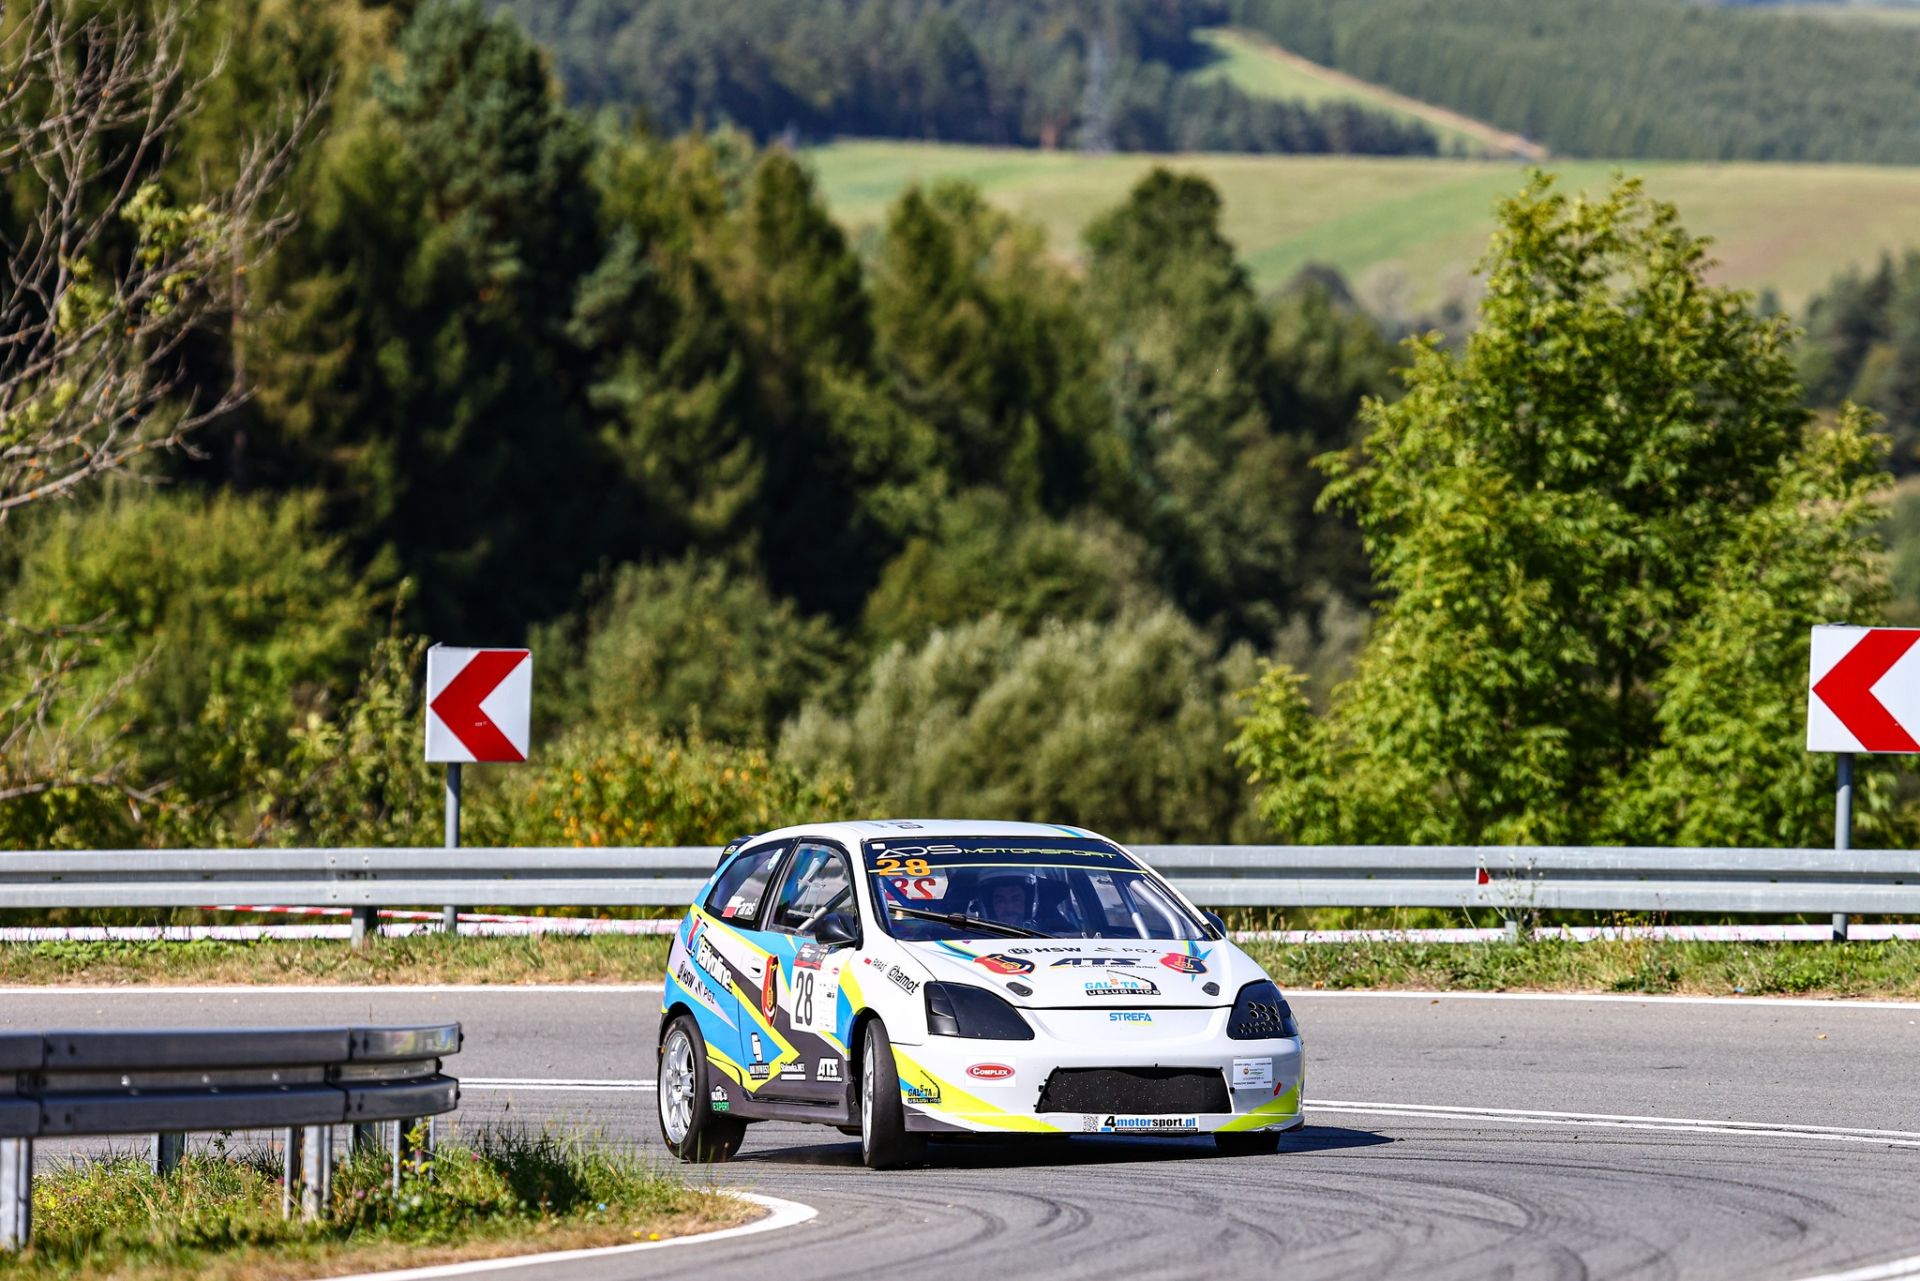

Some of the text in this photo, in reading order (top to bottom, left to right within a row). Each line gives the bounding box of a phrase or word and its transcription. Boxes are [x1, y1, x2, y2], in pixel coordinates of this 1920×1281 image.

[964, 847, 1117, 859] MOTORSPORT
[876, 858, 931, 876] 28
[1049, 957, 1141, 968] ATS
[795, 971, 814, 1026] 28
[1109, 1012, 1152, 1021] STREFA
[817, 1058, 839, 1076] ATS
[1104, 1115, 1197, 1127] 4motorsport.pl
